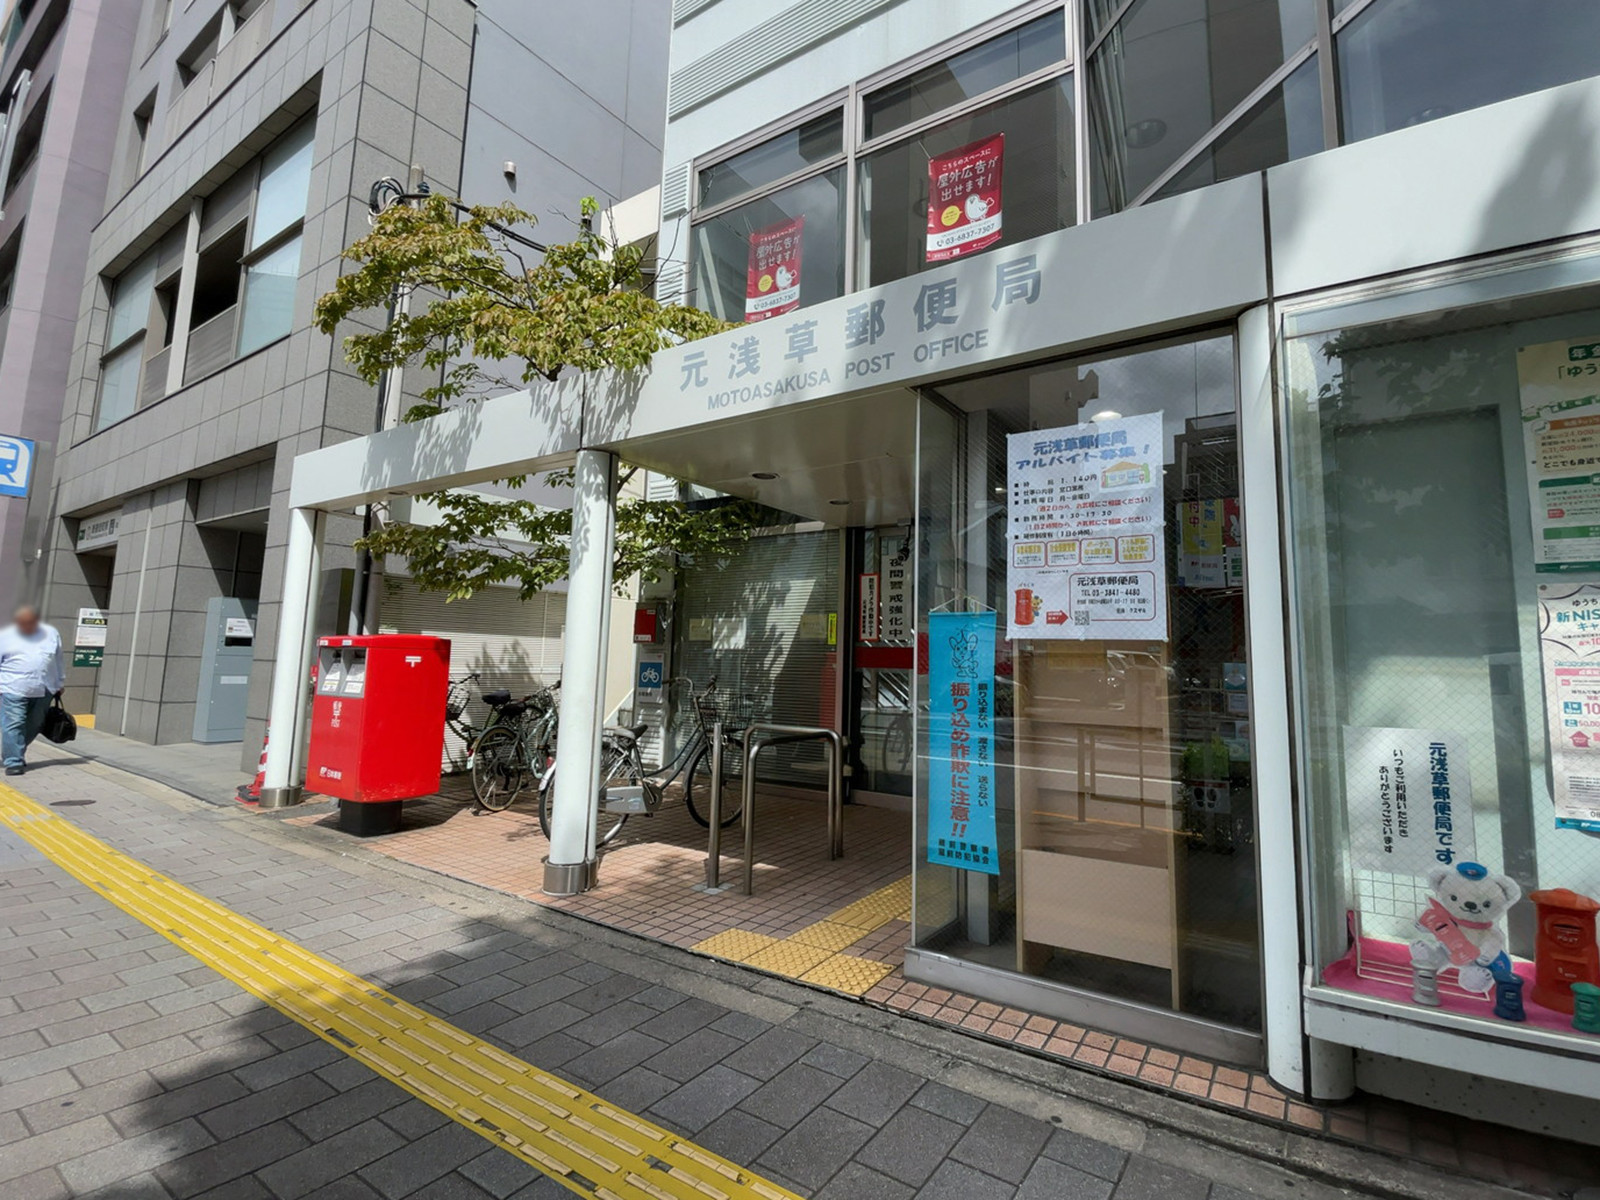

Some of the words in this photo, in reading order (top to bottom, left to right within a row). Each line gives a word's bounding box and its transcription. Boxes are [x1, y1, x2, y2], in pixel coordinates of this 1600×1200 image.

[937, 156, 999, 188] 屋外広告が
[942, 148, 991, 171] こちらのスペースに
[680, 254, 1042, 392] 元浅草郵便局
[707, 368, 831, 410] MOTOASAKUSA
[845, 352, 895, 379] POST
[913, 328, 989, 363] OFFICE
[1033, 430, 1128, 456] 元浅草郵便局
[1077, 575, 1139, 586] 元浅草郵便局
[978, 683, 988, 728] 振り込まない
[950, 682, 971, 838] 振り込め詐欺に注意!!
[1393, 749, 1408, 838] いつもご利用いただき
[1379, 766, 1393, 854] ありがとうございます
[1429, 742, 1456, 865] 元浅草郵便局です
